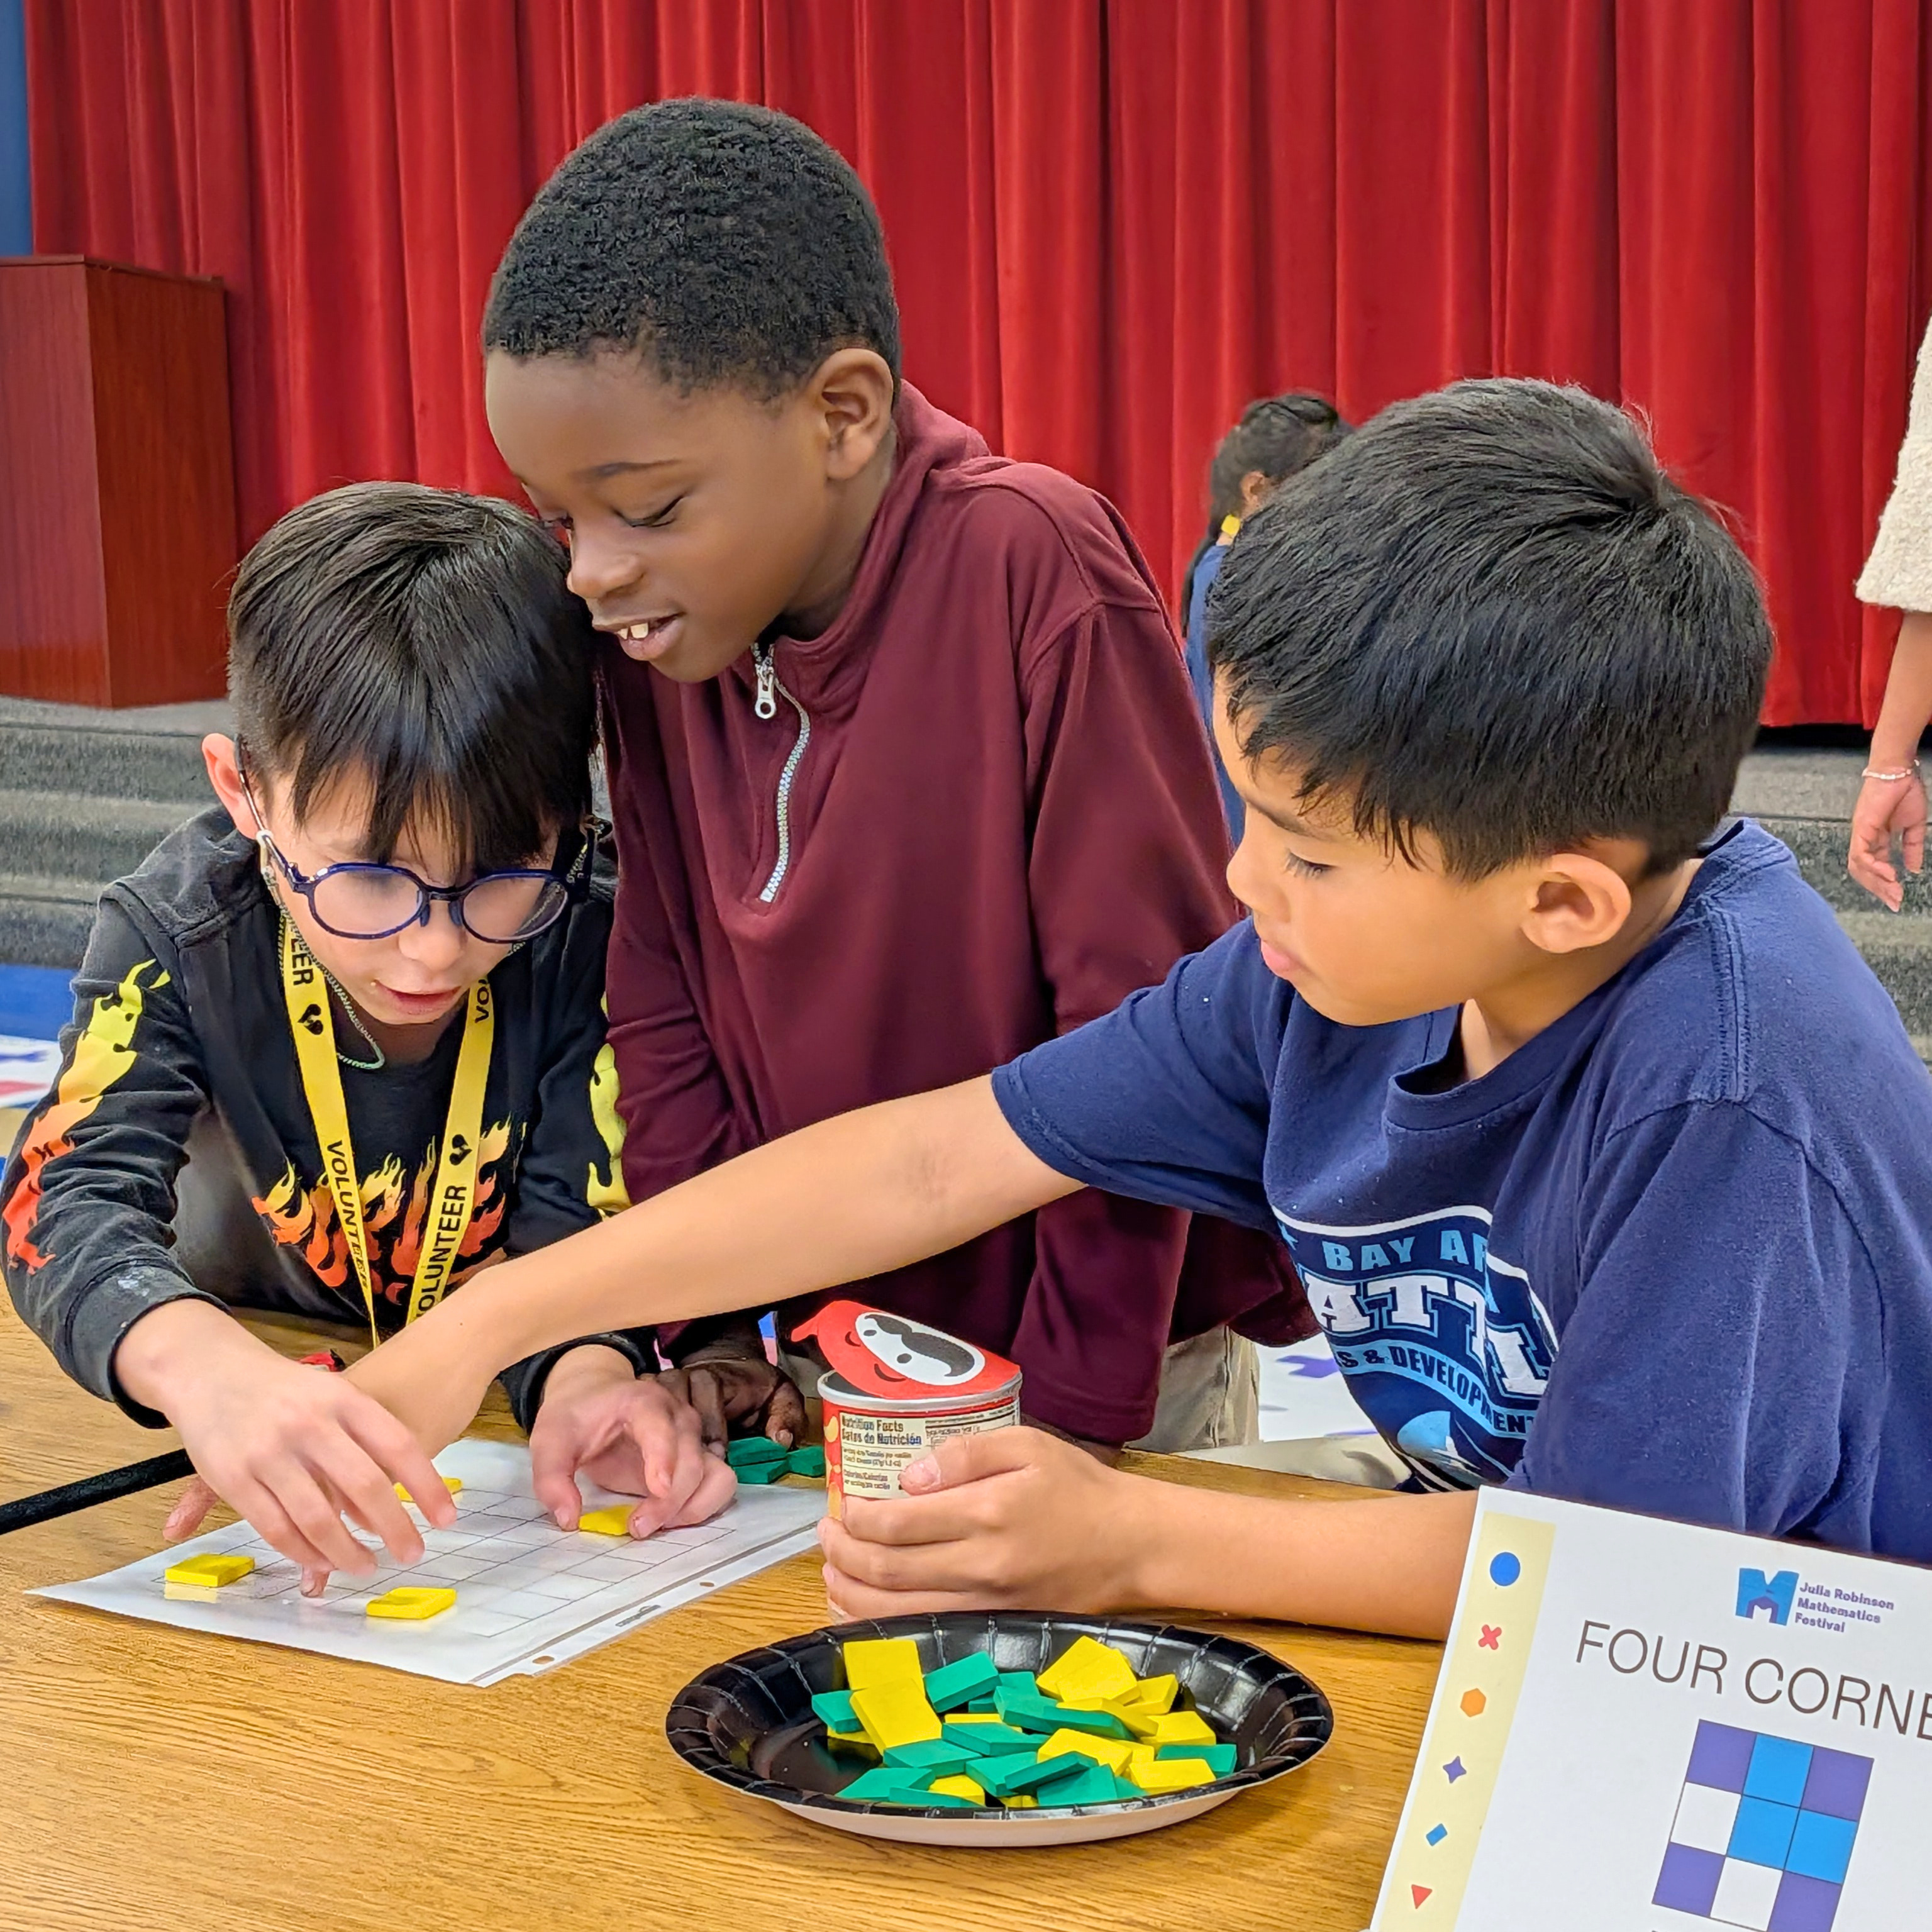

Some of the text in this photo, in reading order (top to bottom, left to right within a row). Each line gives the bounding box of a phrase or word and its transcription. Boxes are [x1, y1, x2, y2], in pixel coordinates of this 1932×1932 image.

[1322, 1236, 1416, 1271] BAY
[1363, 1350, 1384, 1364] &
[877, 1419, 903, 1432] Facts
[1799, 1582, 1894, 1610] Julia Robinson
[1794, 1613, 1846, 1633] Festival
[1797, 1597, 1881, 1623] Mathematics
[1575, 1620, 1729, 1695] FOUR
